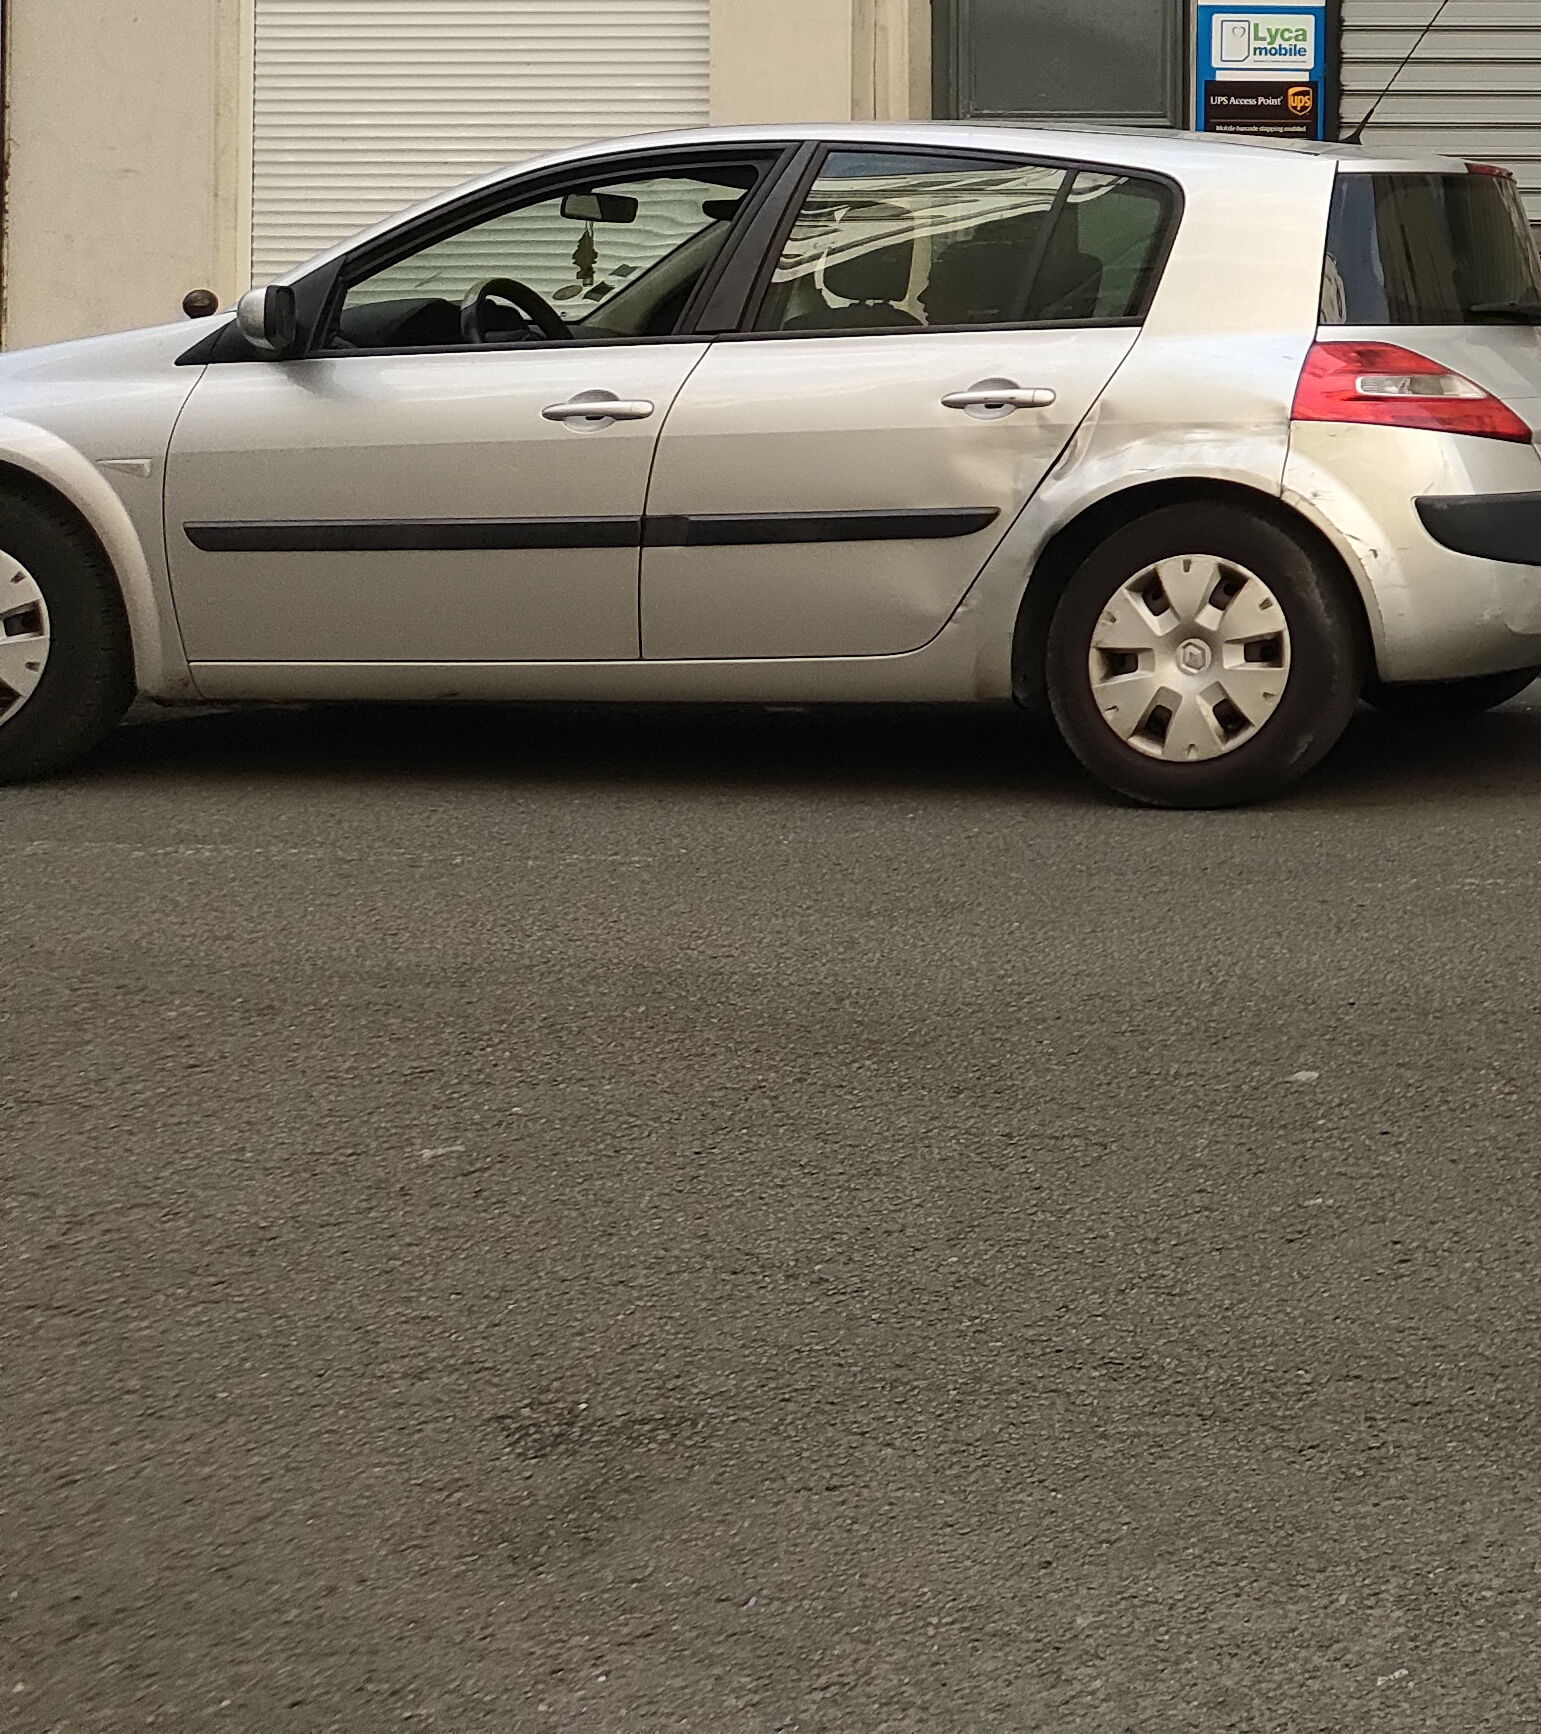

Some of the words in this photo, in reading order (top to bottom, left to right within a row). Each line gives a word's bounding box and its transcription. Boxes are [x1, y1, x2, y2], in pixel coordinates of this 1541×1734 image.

[1253, 22, 1308, 45] Lyca
[1252, 43, 1308, 57] mobile
[1210, 96, 1228, 105] UPS
[1229, 96, 1257, 105] Access
[1291, 95, 1311, 111] ups
